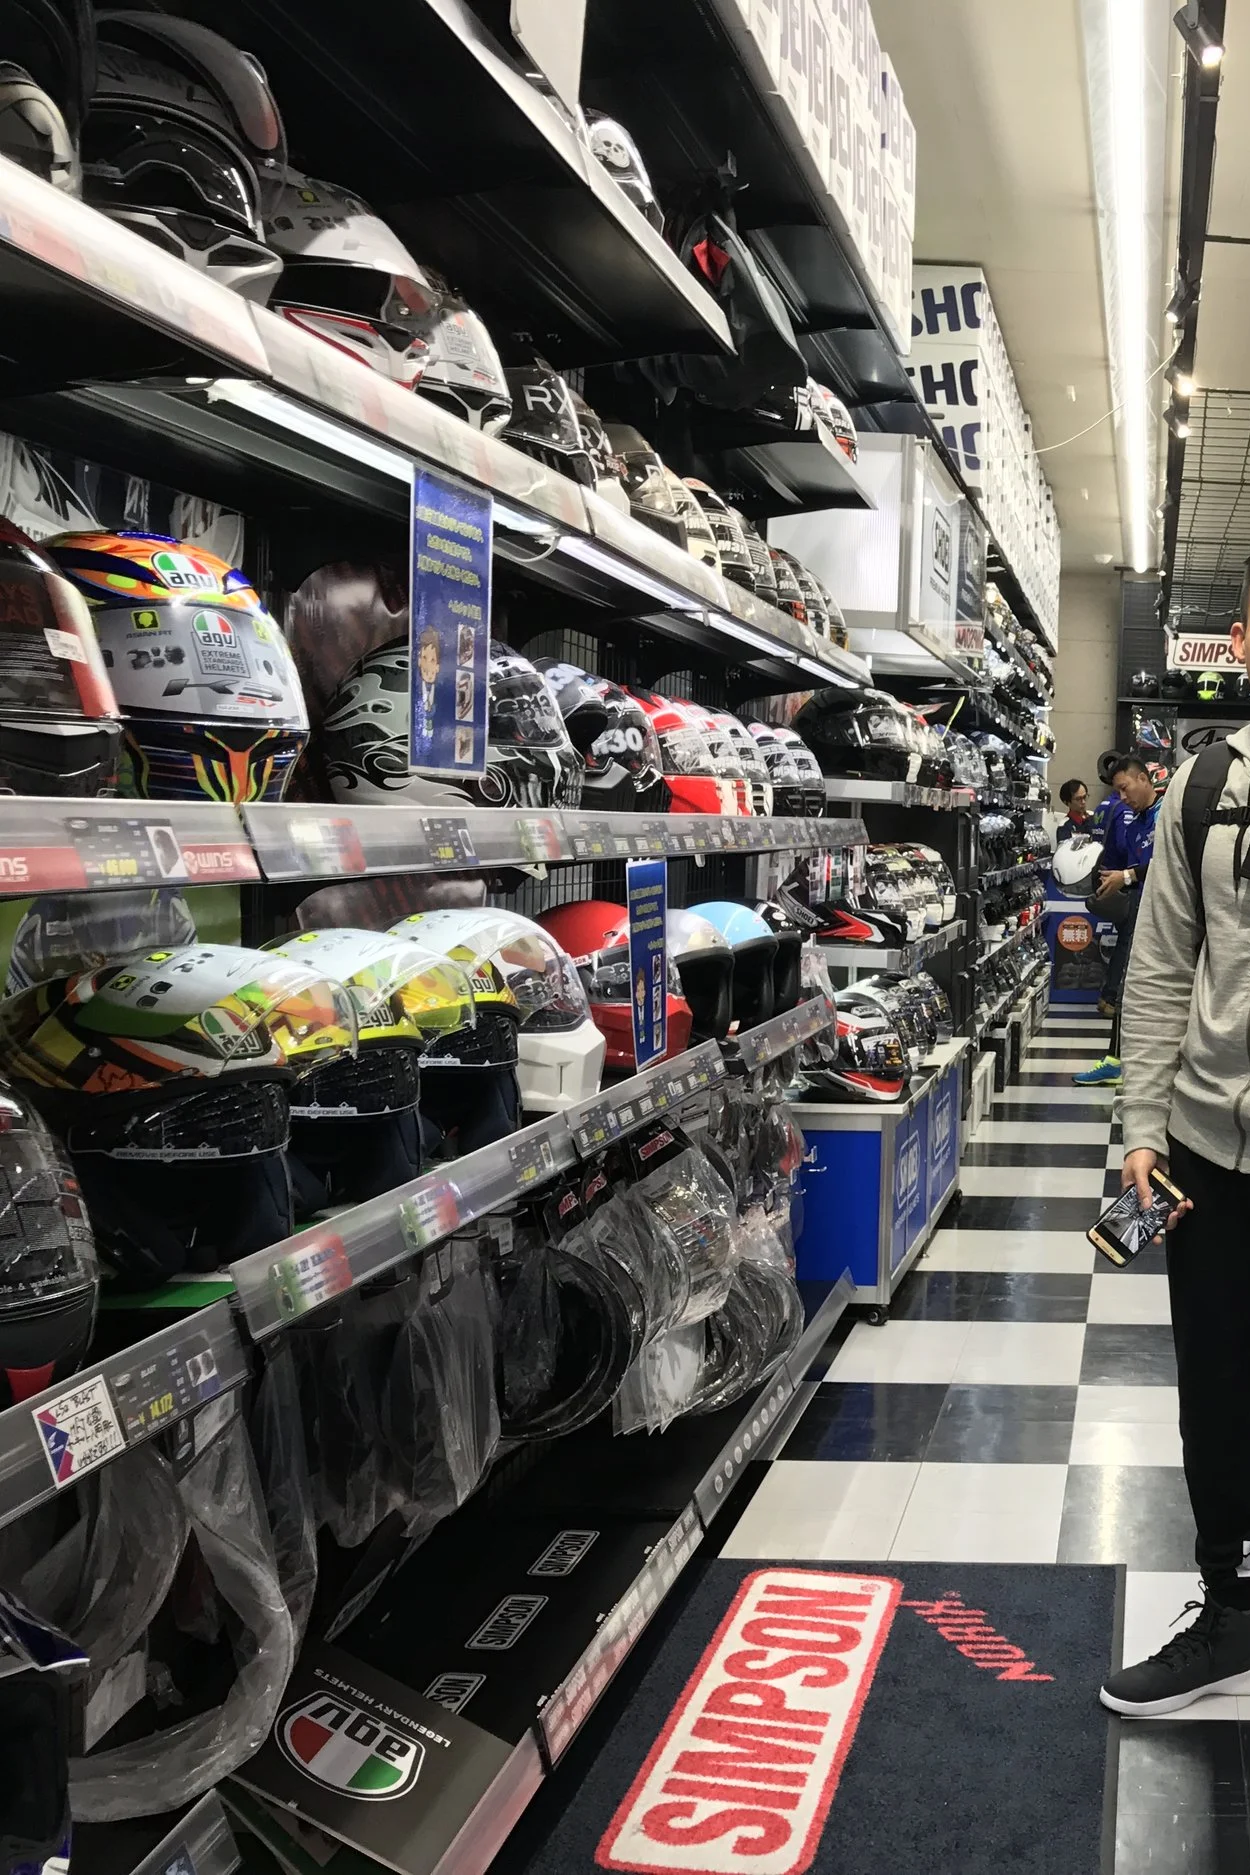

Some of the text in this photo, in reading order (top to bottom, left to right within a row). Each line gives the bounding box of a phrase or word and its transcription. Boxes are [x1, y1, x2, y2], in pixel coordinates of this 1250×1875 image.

[201, 631, 234, 648] agv
[201, 650, 241, 659] EXTREME
[1179, 641, 1246, 665] SIMPS
[204, 664, 247, 674] HELMETS
[1061, 928, 1088, 943] 無料
[537, 1533, 591, 1574] SIMPSON
[477, 1598, 541, 1647] SIMPSON
[312, 1667, 451, 1748] LEGENDARY HELMETS
[640, 1583, 863, 1856] SIMPSON
[308, 1701, 413, 1762] agv
